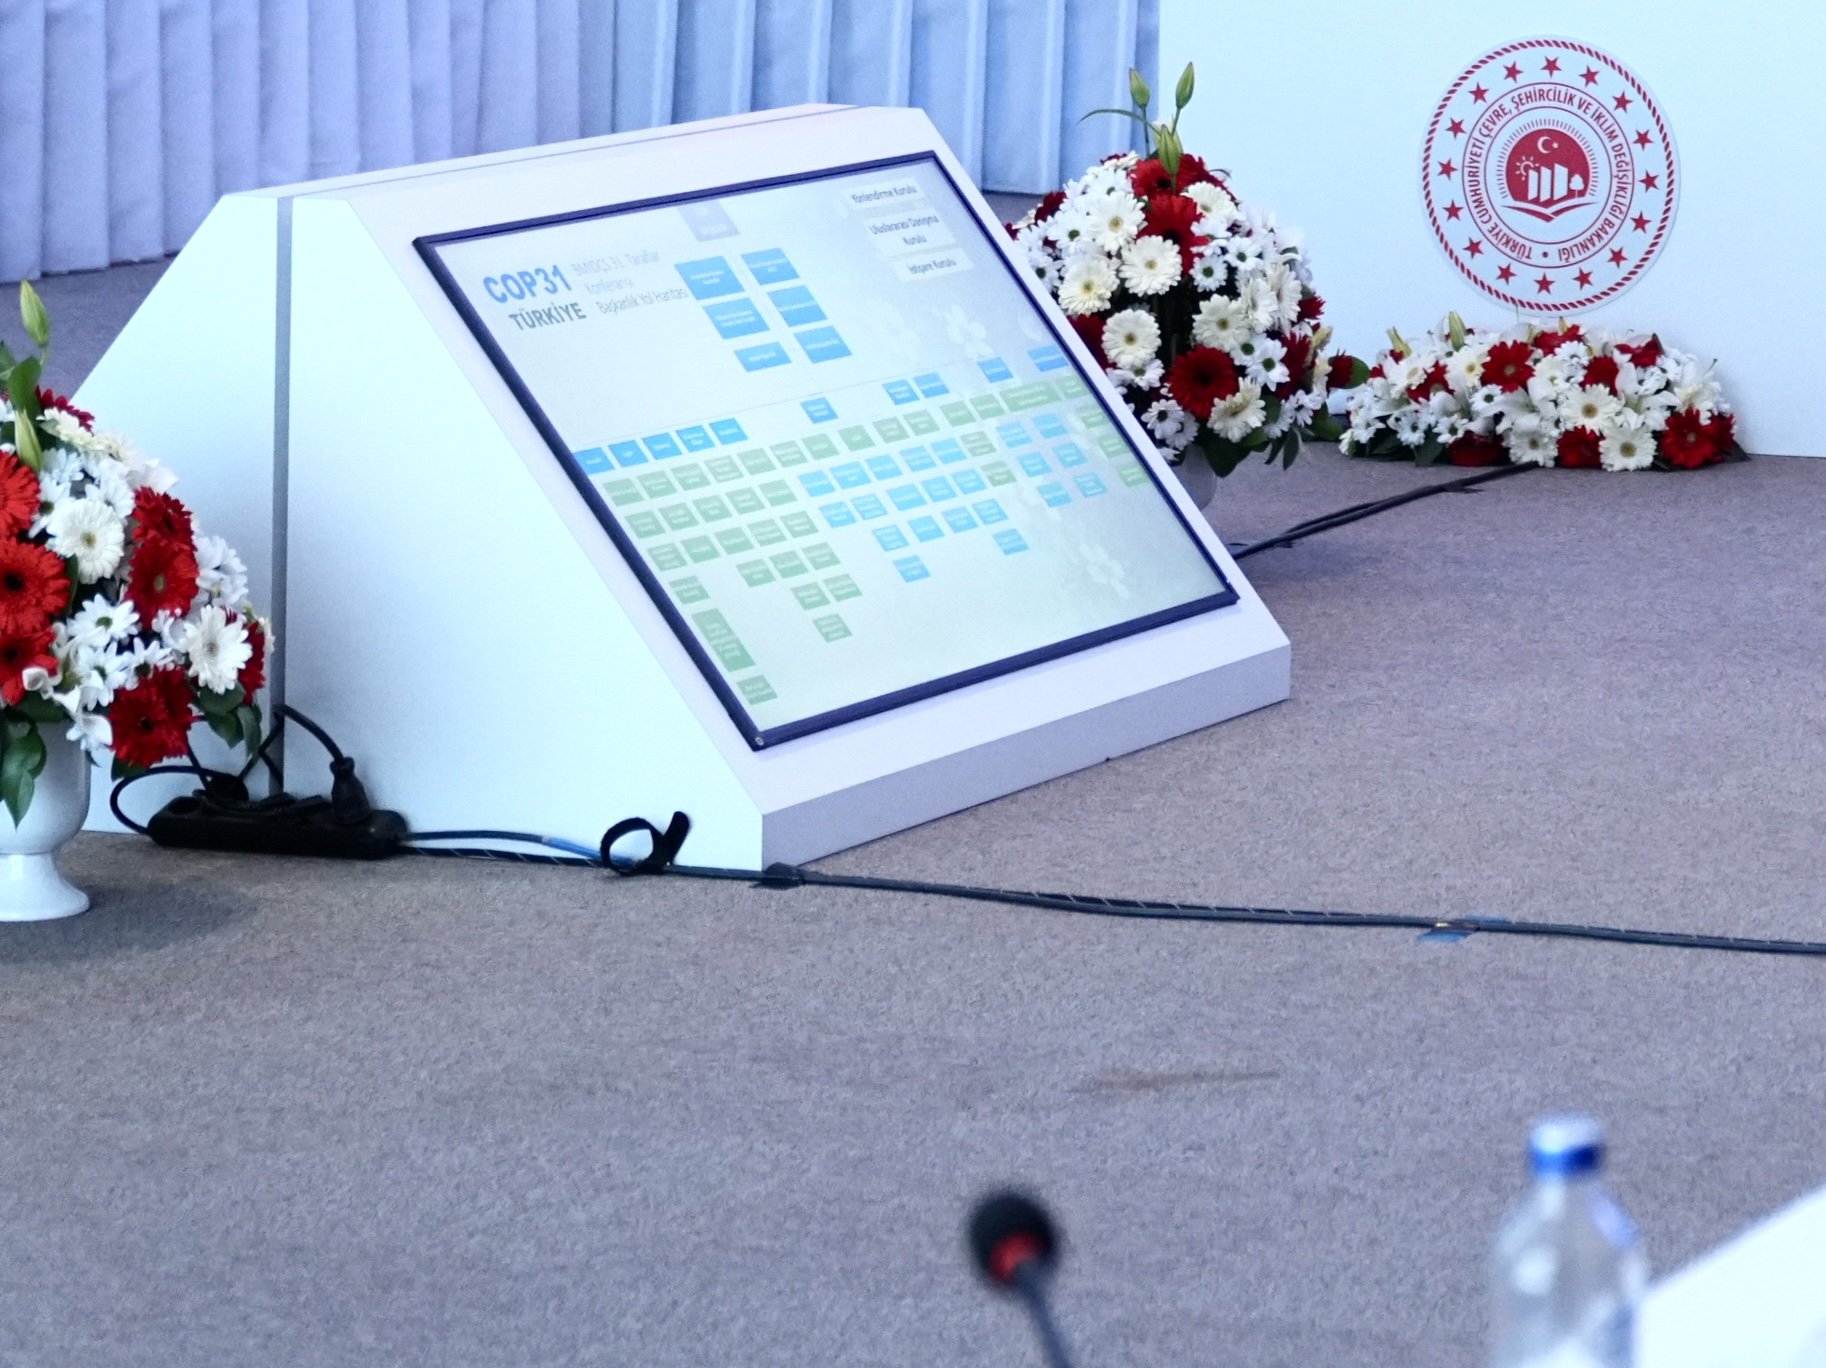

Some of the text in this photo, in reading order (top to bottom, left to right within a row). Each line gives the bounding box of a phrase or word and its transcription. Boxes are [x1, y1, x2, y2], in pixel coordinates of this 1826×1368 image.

[1465, 86, 1632, 262] TÜRKİYE CUMHURİYETİ ÇEVRE, ŞEHİRCİLİK VE İKLİM DEĞİŞİKLİĞİ BAKANLIĞI
[482, 264, 573, 305] COP31
[508, 299, 587, 331] TÜRKİYE
